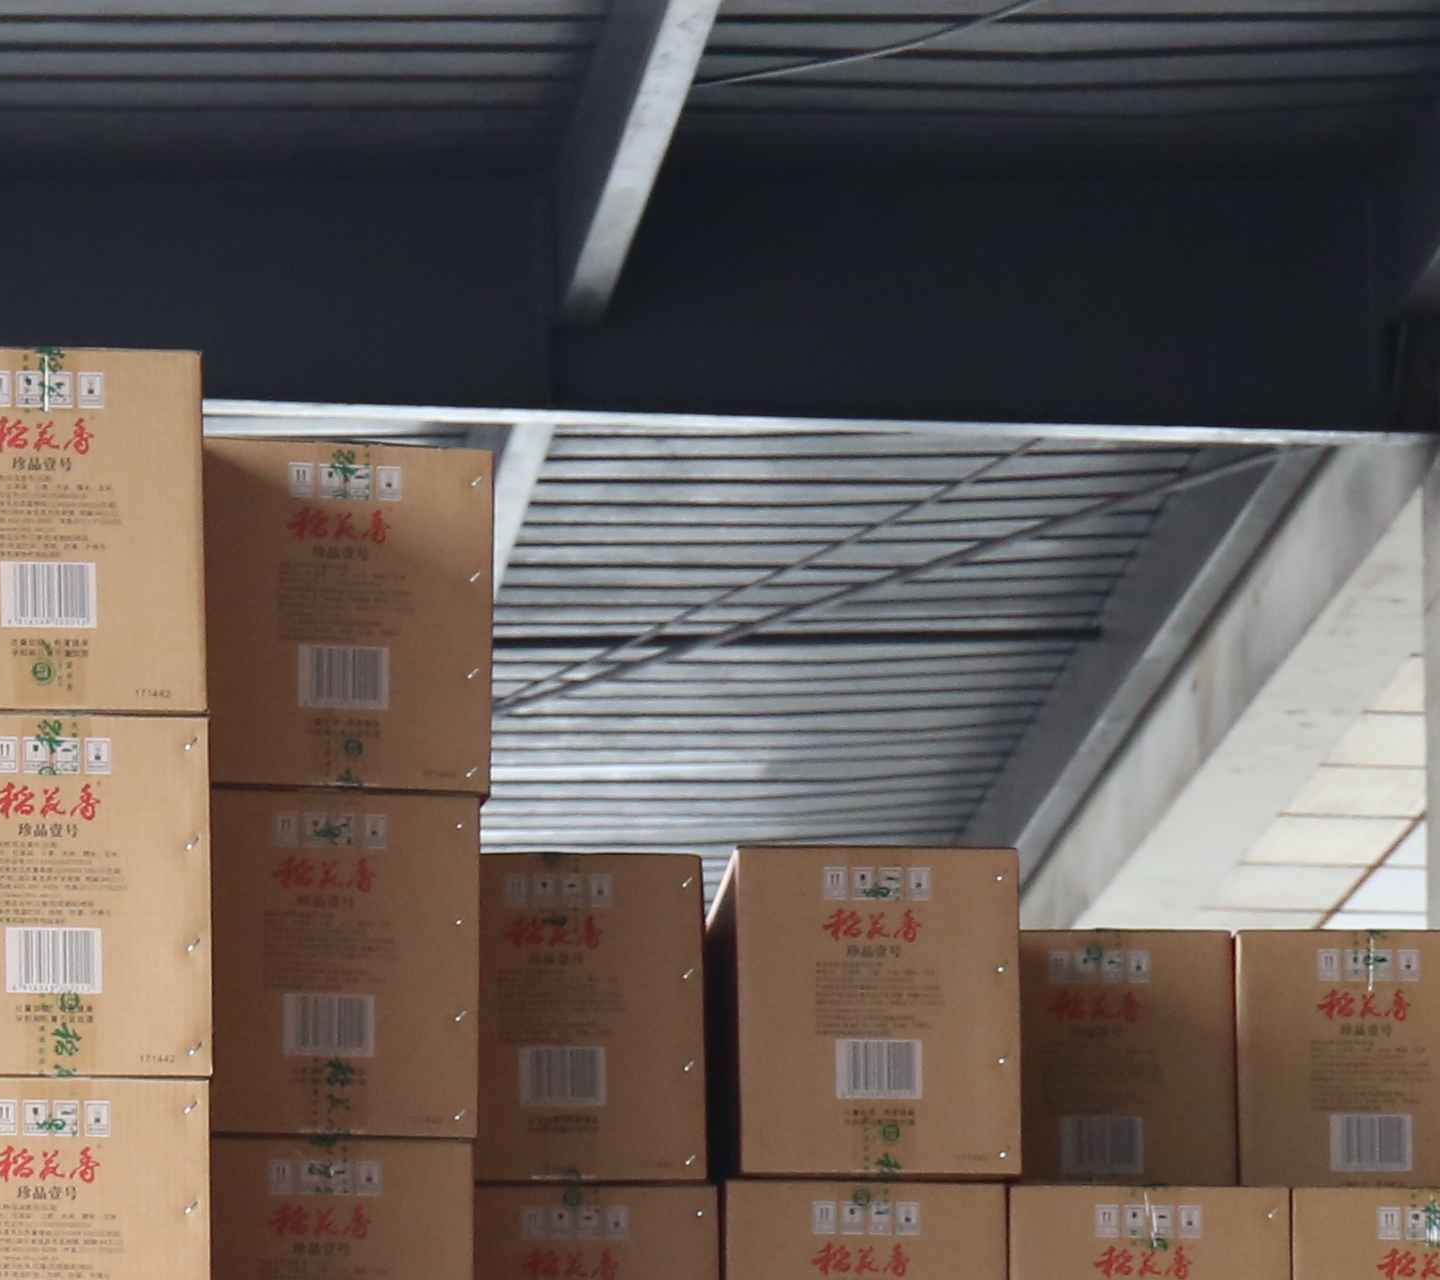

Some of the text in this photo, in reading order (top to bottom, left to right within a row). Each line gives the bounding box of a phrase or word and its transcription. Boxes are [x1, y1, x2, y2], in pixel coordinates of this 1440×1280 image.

[824, 908, 921, 945] 稻花香
[810, 1239, 909, 1280] 稻花香
